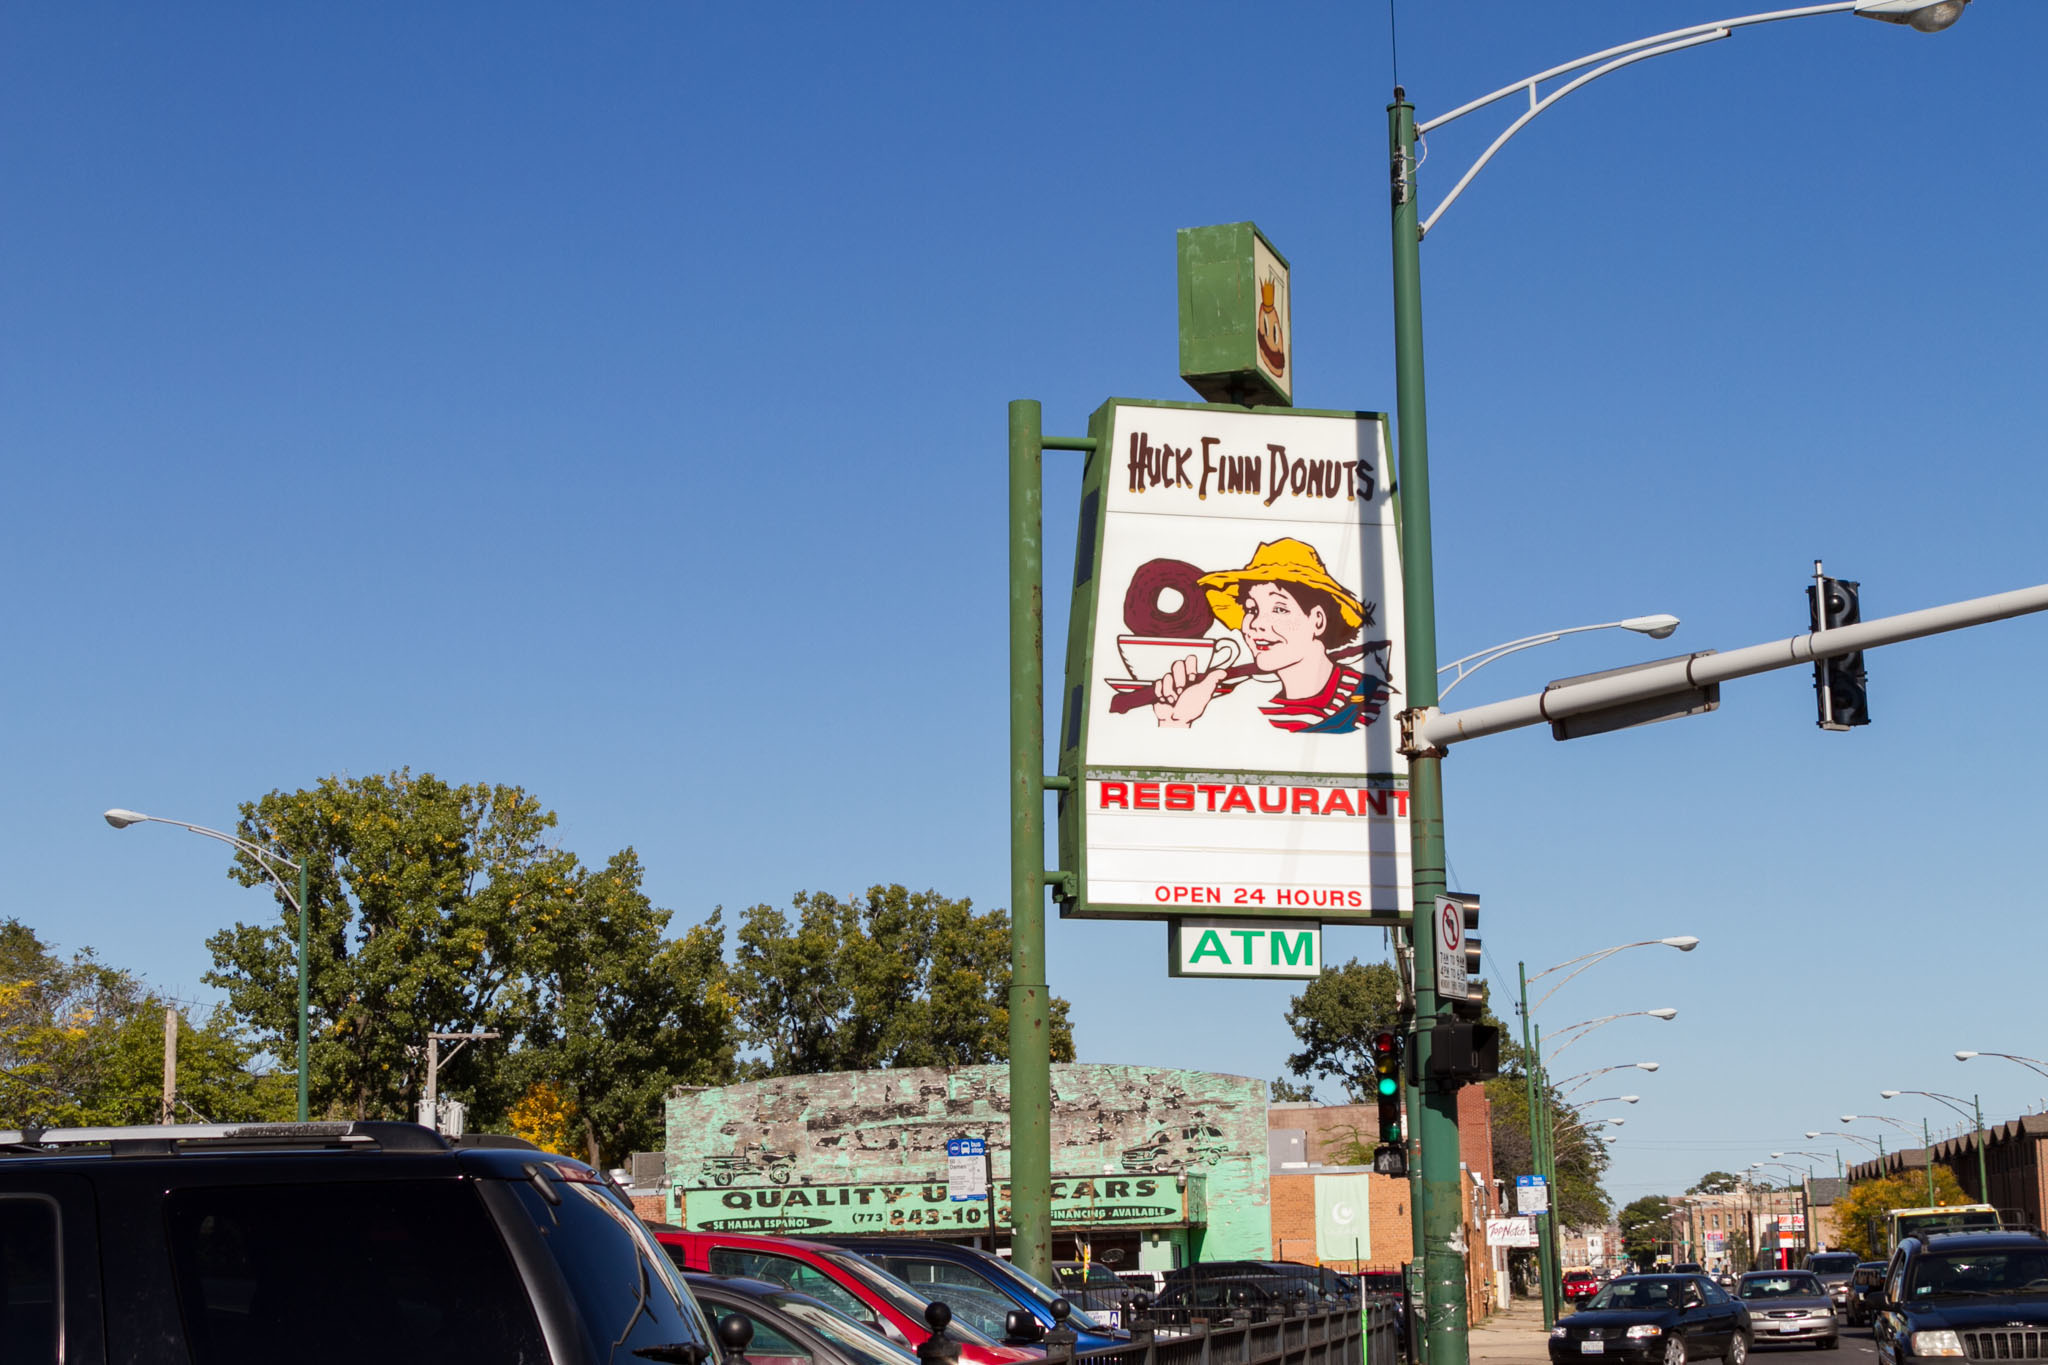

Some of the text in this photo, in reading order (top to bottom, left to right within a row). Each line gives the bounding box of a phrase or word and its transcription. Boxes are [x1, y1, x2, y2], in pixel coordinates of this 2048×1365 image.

[1128, 432, 1375, 507] HUCK FINN DONUTS
[1100, 782, 1409, 817] RESTAURANT
[1155, 886, 1362, 907] OPEN 24 HOURS
[1188, 930, 1313, 966] ATM
[722, 1187, 904, 1209] QUALITY
[1050, 1180, 1157, 1200] CARS
[713, 1216, 810, 1230] SE HABLA ESPAÑOL
[1112, 1207, 1166, 1217] AVAILABLE
